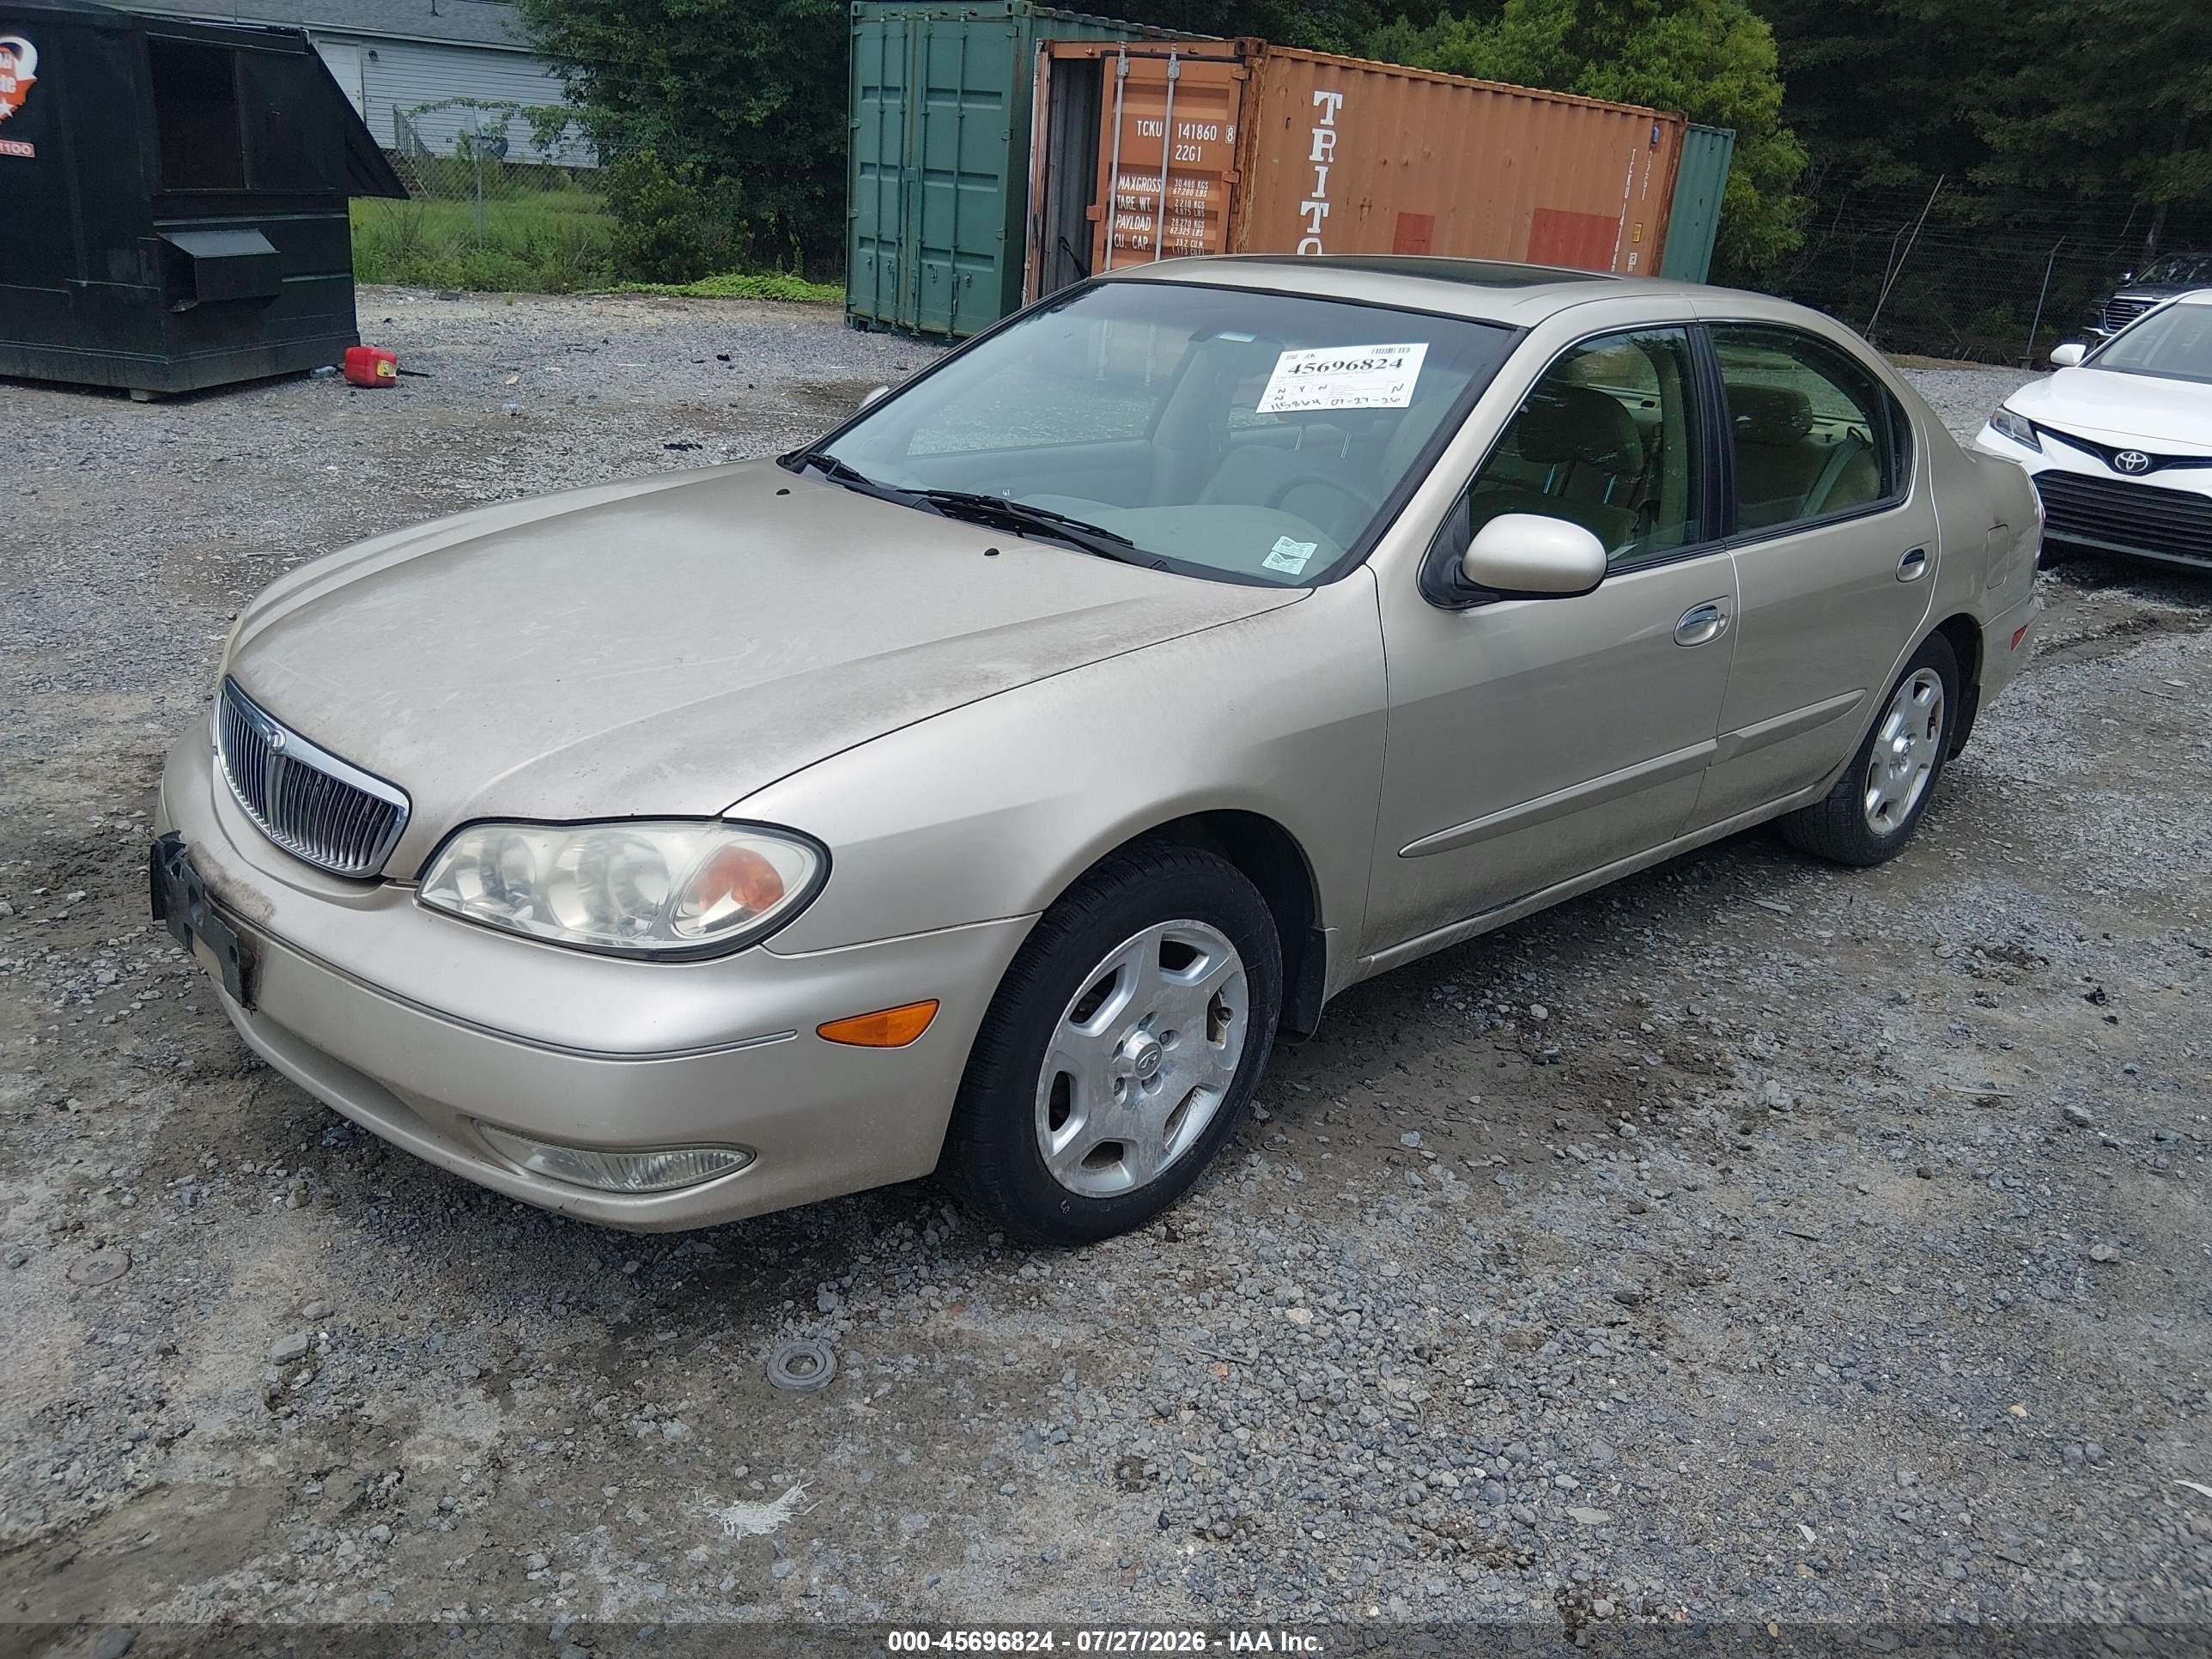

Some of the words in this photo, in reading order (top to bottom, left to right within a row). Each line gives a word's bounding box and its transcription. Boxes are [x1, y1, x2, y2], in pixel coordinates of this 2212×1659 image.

[1136, 120, 1164, 137] TCKU
[1177, 123, 1218, 142] 141860
[1226, 126, 1235, 143] 8
[1175, 144, 1202, 162] 22G1
[1195, 189, 1207, 198] LBS
[1197, 180, 1209, 190] KGS
[1116, 195, 1137, 211] TARE
[1194, 200, 1205, 210] KGS
[1115, 215, 1152, 232] PAYLOAD
[1194, 220, 1205, 229] KGS
[1192, 228, 1204, 237] LBS
[1114, 234, 1127, 249] CU.
[1132, 234, 1152, 251] CAP.
[1288, 357, 1404, 375] 45696824
